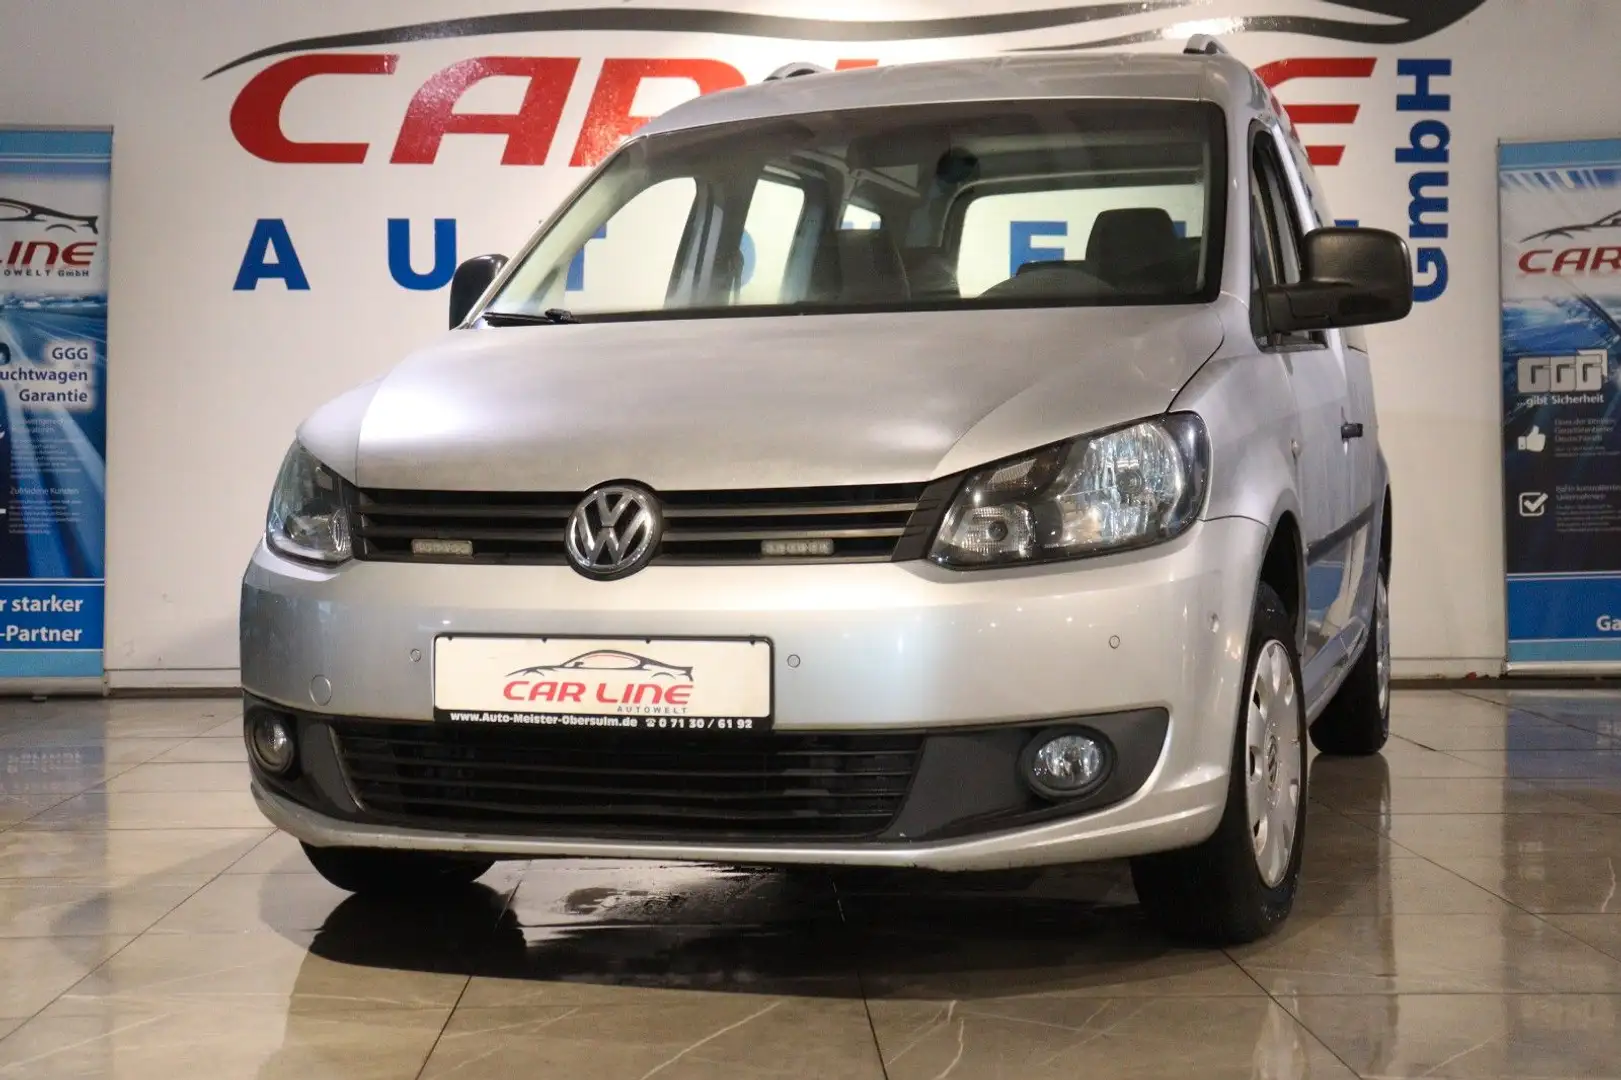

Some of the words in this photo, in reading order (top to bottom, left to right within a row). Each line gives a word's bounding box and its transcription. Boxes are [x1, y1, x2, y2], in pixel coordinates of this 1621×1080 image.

[1395, 59, 1451, 302] GmbH
[0, 241, 98, 266] INE
[1519, 246, 1621, 273] CAR
[52, 347, 89, 360] GGG
[19, 388, 88, 402] Garantie
[1552, 394, 1605, 404] Sicherheit
[11, 594, 84, 612] starker
[503, 681, 586, 702] CAR
[596, 682, 693, 705] LINE
[616, 705, 688, 715] AUTOWELT
[450, 711, 638, 728] www.Auto-Meister-Obersulm.de
